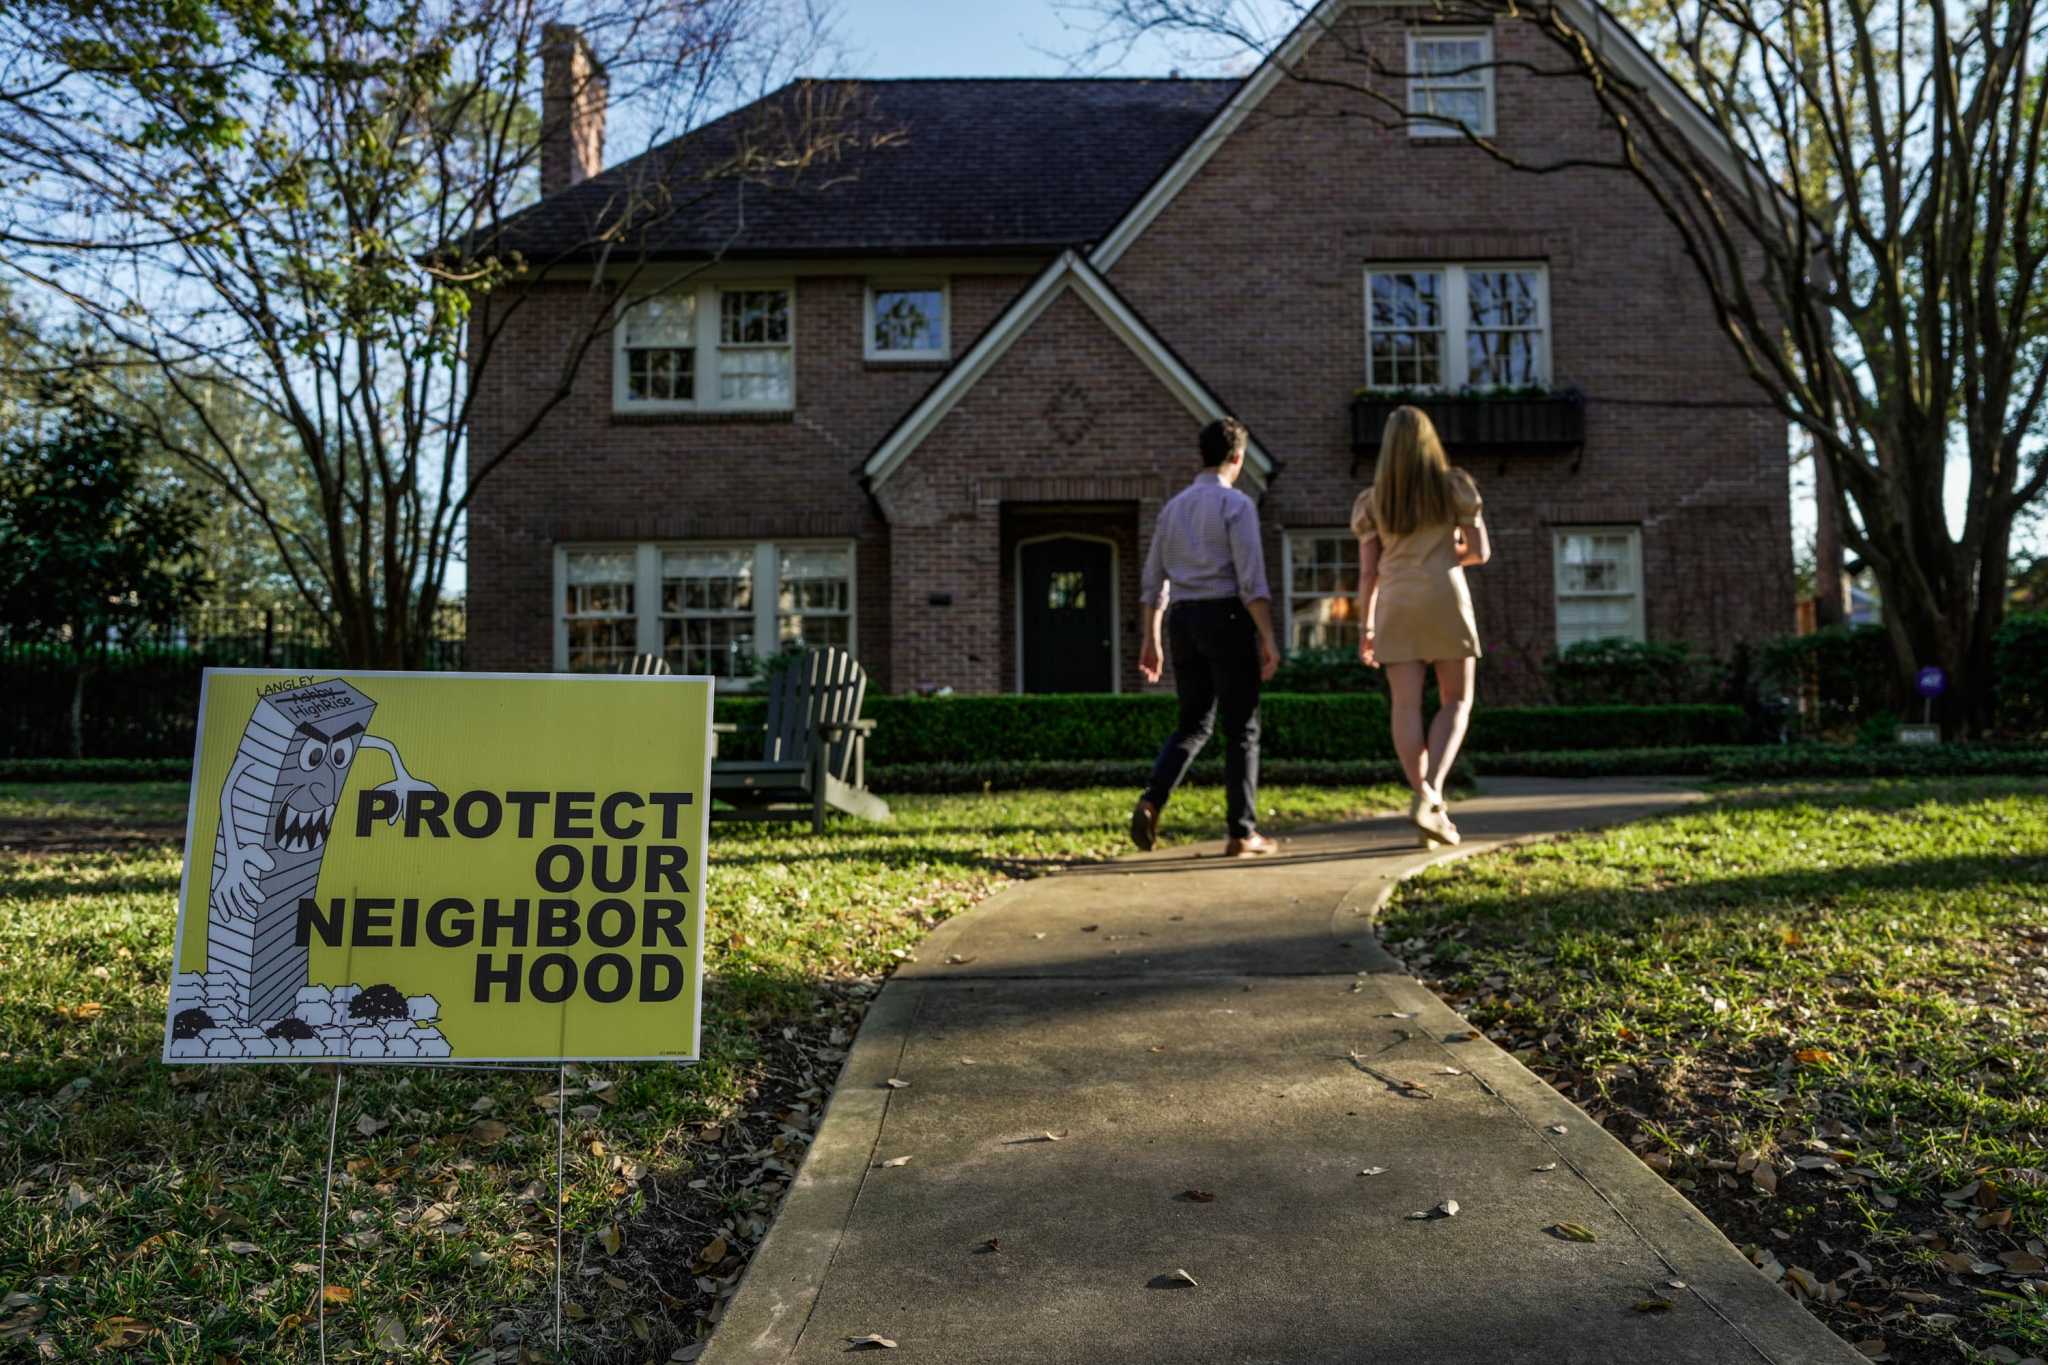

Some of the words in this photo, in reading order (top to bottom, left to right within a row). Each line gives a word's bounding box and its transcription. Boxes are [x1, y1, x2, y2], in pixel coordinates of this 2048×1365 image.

[256, 676, 315, 697] LANGLEY
[356, 790, 694, 840] PROTECT
[535, 845, 690, 893] OUR
[295, 898, 688, 947] NEIGHBOR
[473, 953, 684, 1004] HOOD
